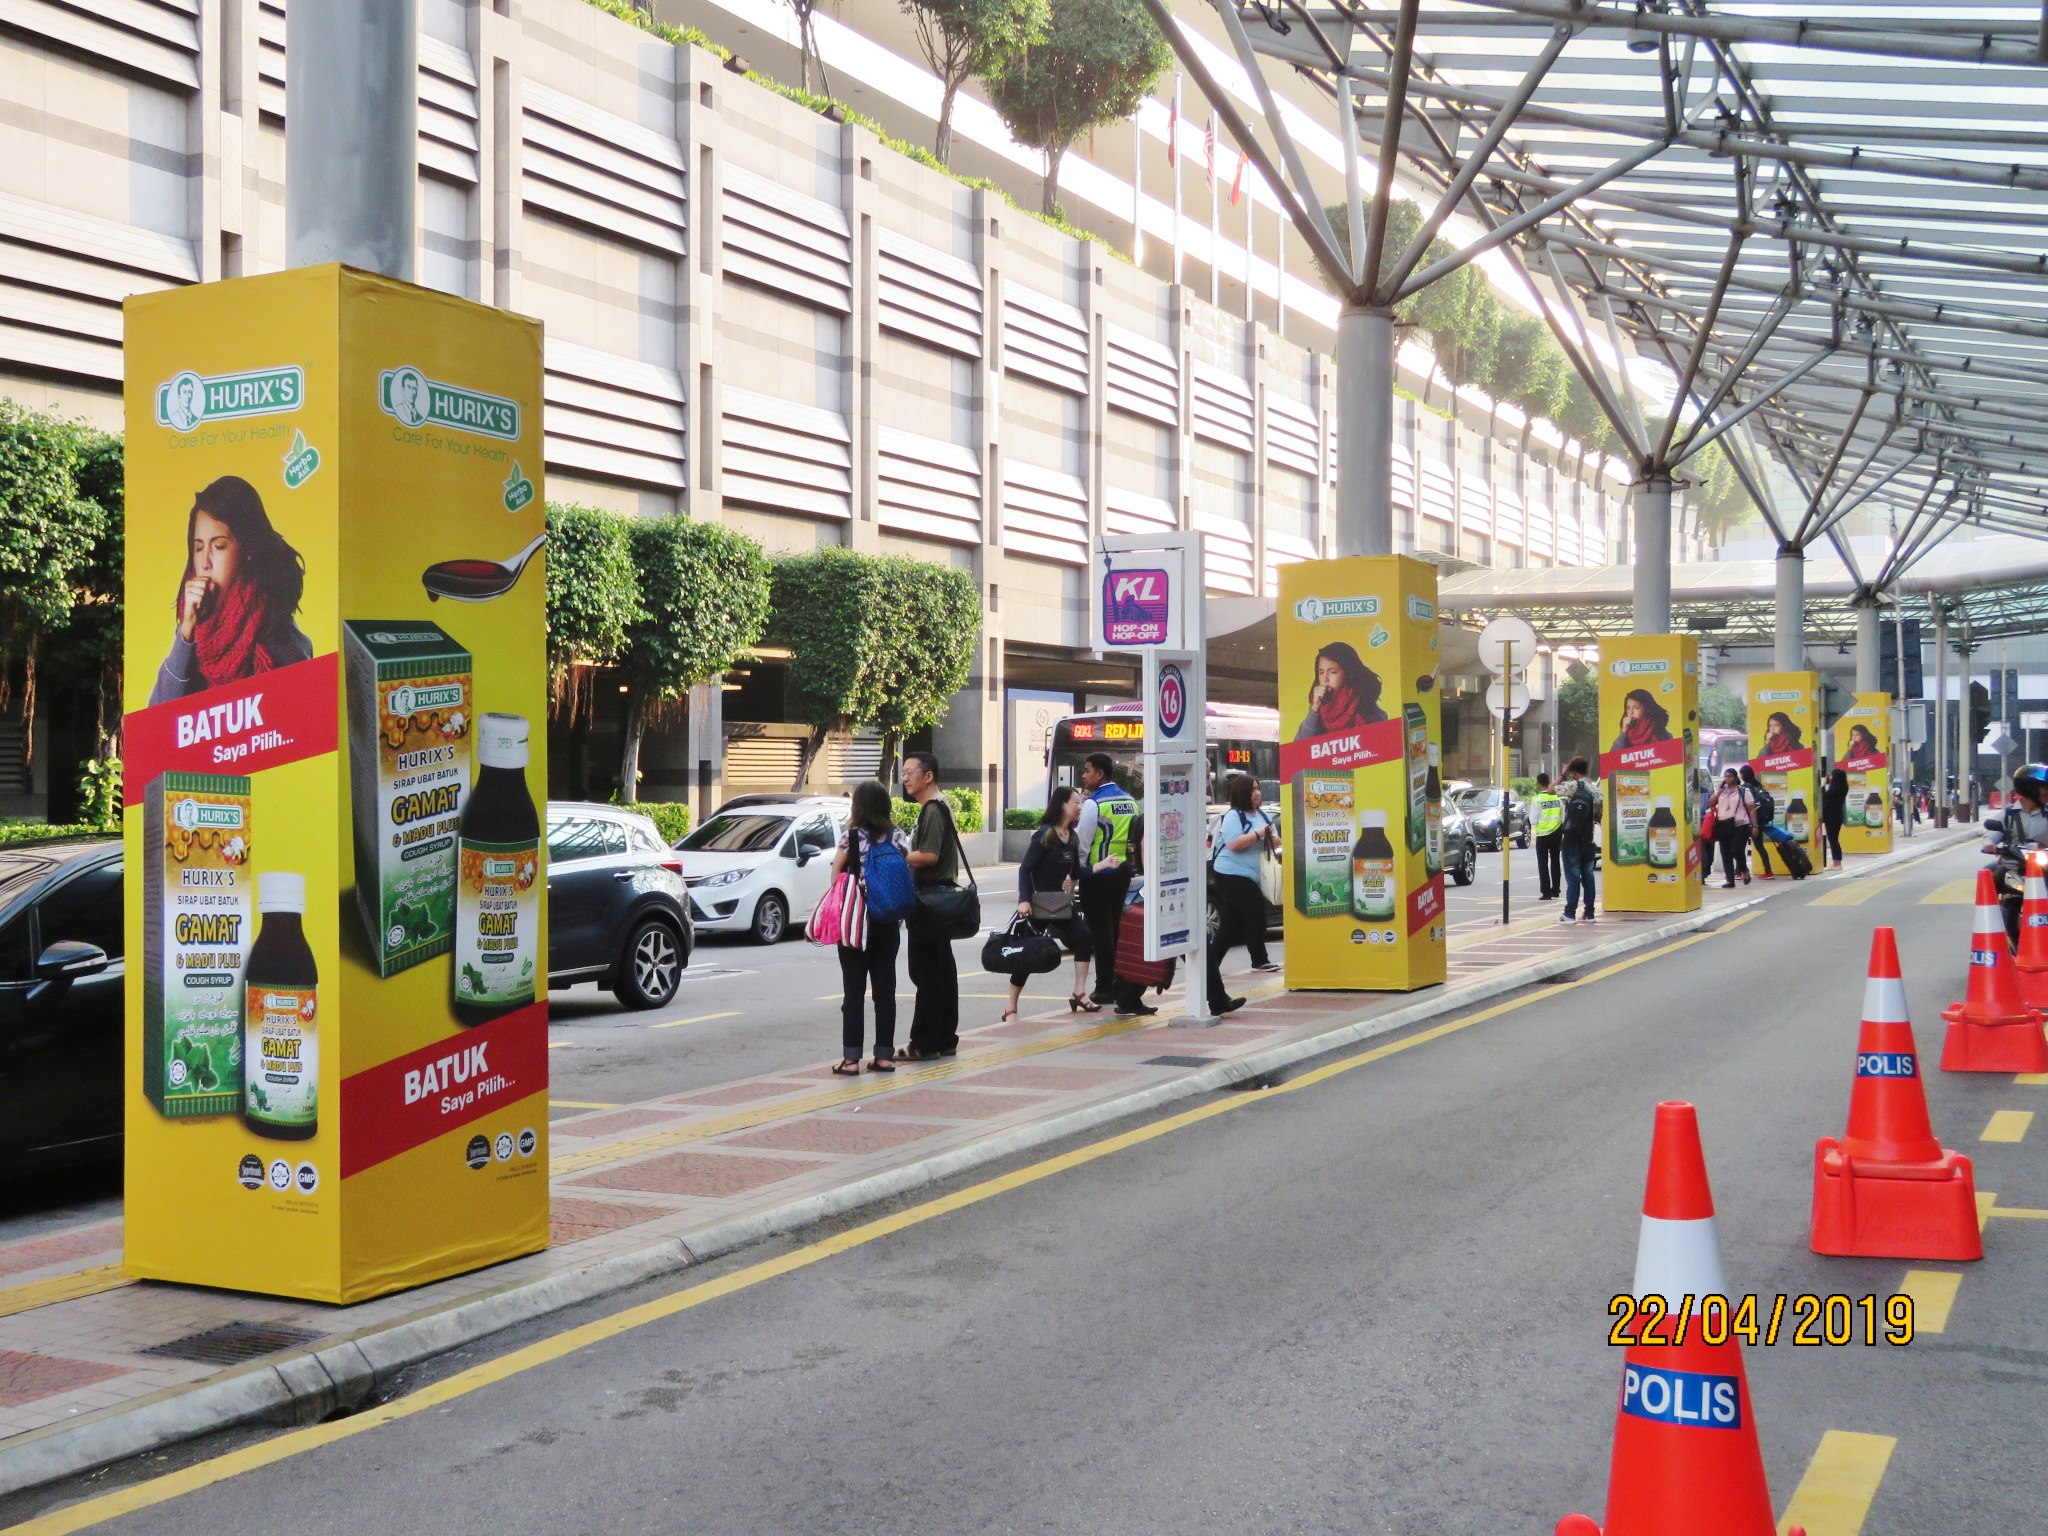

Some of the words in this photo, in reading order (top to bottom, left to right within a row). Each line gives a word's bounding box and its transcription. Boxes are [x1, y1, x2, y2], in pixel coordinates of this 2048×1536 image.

[210, 377, 294, 410] HURIX'S
[435, 393, 512, 430] HURIX'S
[169, 434, 198, 449] Care
[201, 432, 218, 446] For
[222, 428, 246, 444] Your
[251, 423, 290, 440] Health
[392, 427, 421, 445] Care
[426, 434, 443, 449] For
[447, 439, 470, 455] Your
[474, 444, 509, 462] Health
[289, 454, 312, 476] Herba
[508, 485, 528, 500] Herba
[1115, 577, 1160, 601] KL
[1326, 601, 1374, 614] HURIX'S
[1112, 632, 1160, 640] HOP-OFF
[1113, 624, 1158, 632] HOP-ON
[1632, 663, 1666, 671] HURIX'S
[418, 690, 459, 705] HURIX'S
[1163, 690, 1178, 714] 16
[178, 693, 264, 748] BATUK
[1105, 723, 1126, 738] RED
[213, 743, 247, 763] Saya
[251, 730, 294, 753] Pilih...
[1310, 734, 1361, 759] BATUK
[1620, 748, 1655, 763] BATUK
[399, 746, 454, 770] HURIX'S
[1332, 755, 1352, 766] Saya
[1765, 755, 1791, 767] BATUK
[394, 777, 416, 789] SIRAP
[418, 773, 435, 783] UBAT
[437, 768, 459, 779] BATUK
[391, 784, 461, 825] GAMAT
[1113, 803, 1133, 811] POLIS
[200, 809, 239, 823] HURIX'S
[402, 825, 434, 845] MADU
[437, 817, 460, 834] PLUS
[1312, 829, 1350, 844] GAMAT
[403, 847, 428, 859] COUGH
[429, 840, 451, 852] SYRUP
[182, 869, 235, 887] HURIX'S
[485, 885, 513, 896] HURIX'S
[177, 895, 197, 905] SIRAP
[200, 896, 216, 905] UBAT
[218, 896, 239, 905] BATUK
[175, 913, 242, 945] GAMAT
[479, 912, 517, 936] GAMAT
[176, 954, 184, 968] &
[185, 953, 216, 969] MADU
[218, 953, 241, 969] PLUS
[186, 976, 210, 985] COUGH
[266, 1014, 297, 1025] HURIX'S
[261, 1037, 301, 1059] GAMAT
[405, 1041, 488, 1105] BATUK
[1858, 1056, 1913, 1074] POLIS
[441, 1091, 474, 1115] Saya
[477, 1074, 516, 1099] Pilih...
[521, 1139, 533, 1148] GMP
[299, 1173, 315, 1183] GMP
[1624, 1368, 1735, 1423] POLIS
